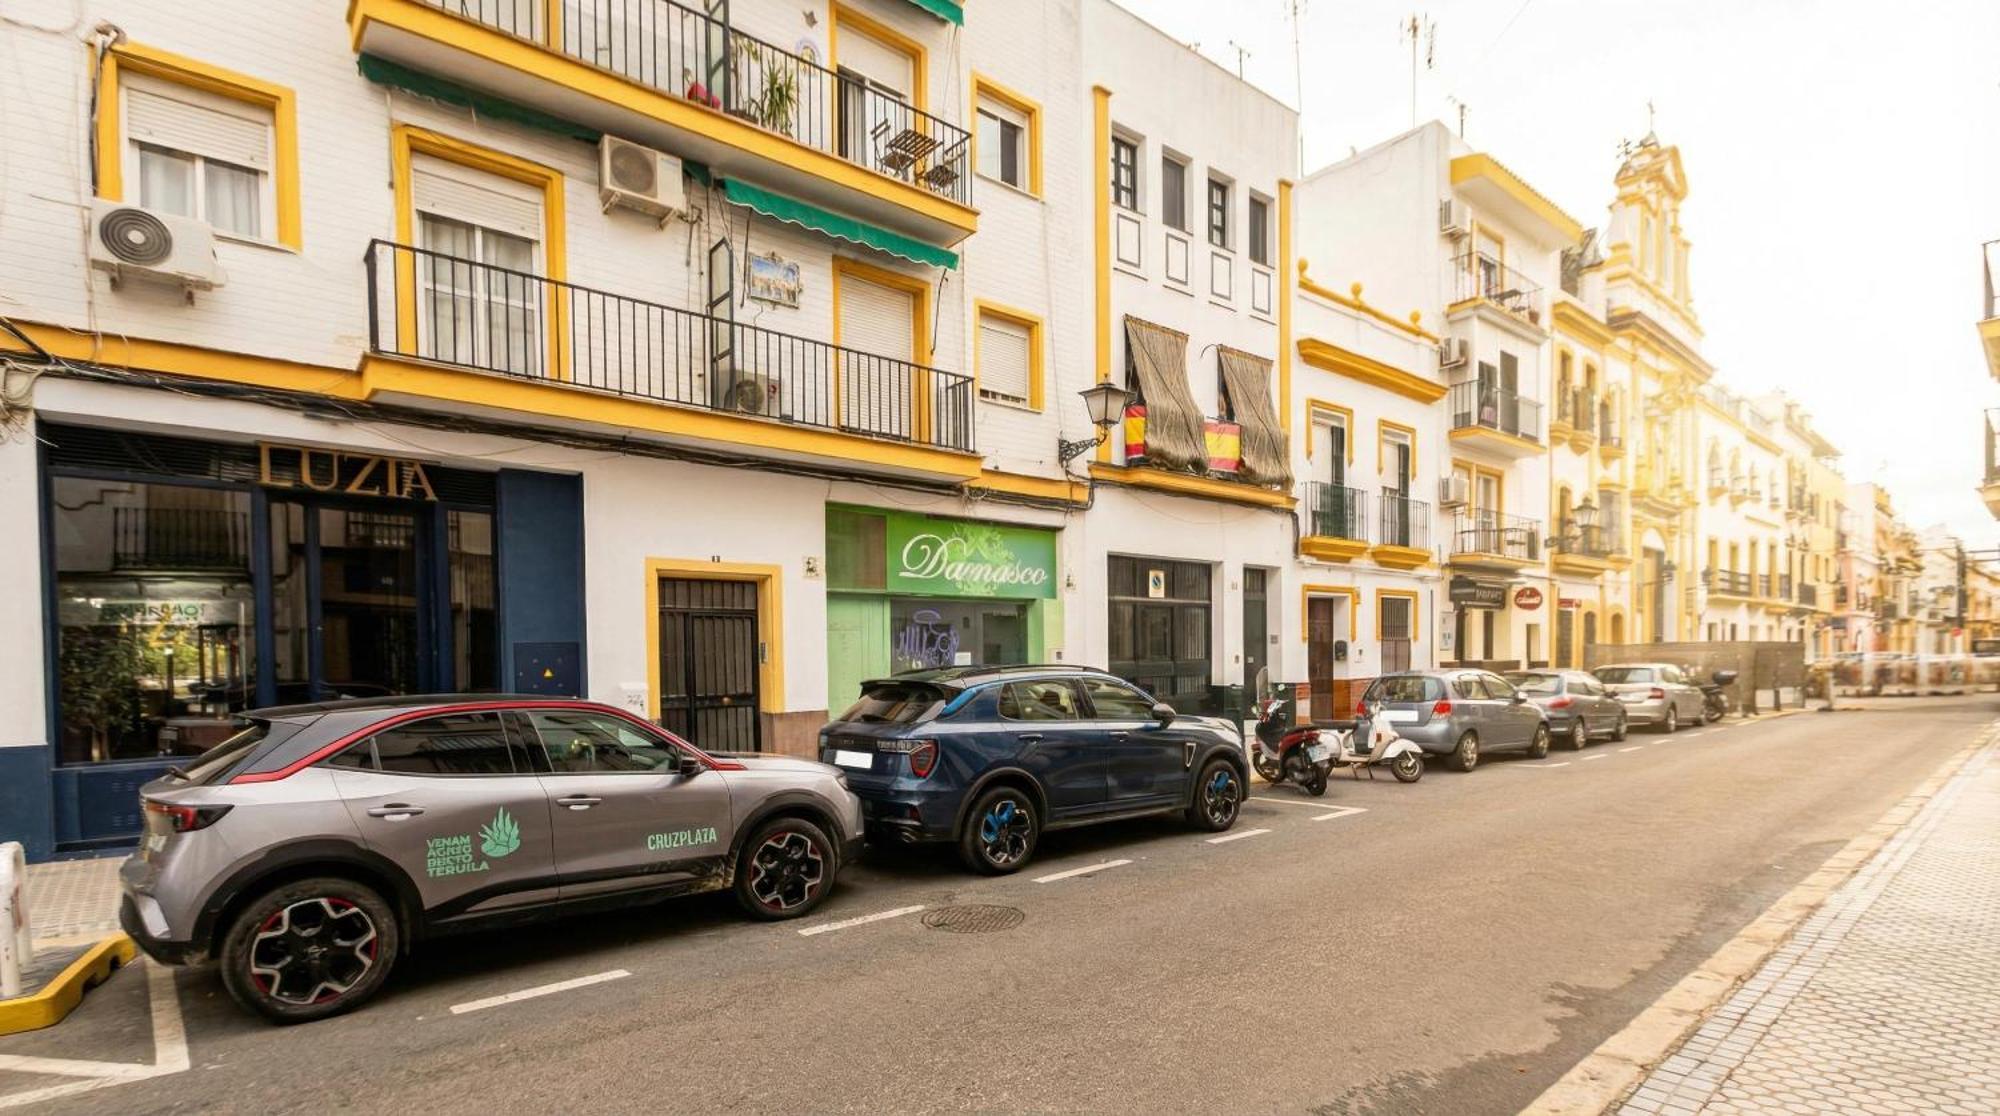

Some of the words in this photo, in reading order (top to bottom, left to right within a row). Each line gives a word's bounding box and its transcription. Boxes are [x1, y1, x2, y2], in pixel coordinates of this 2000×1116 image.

[257, 440, 439, 502] LUZIA
[898, 533, 1047, 584] Damasco
[647, 827, 718, 850] CRUZPLAZA
